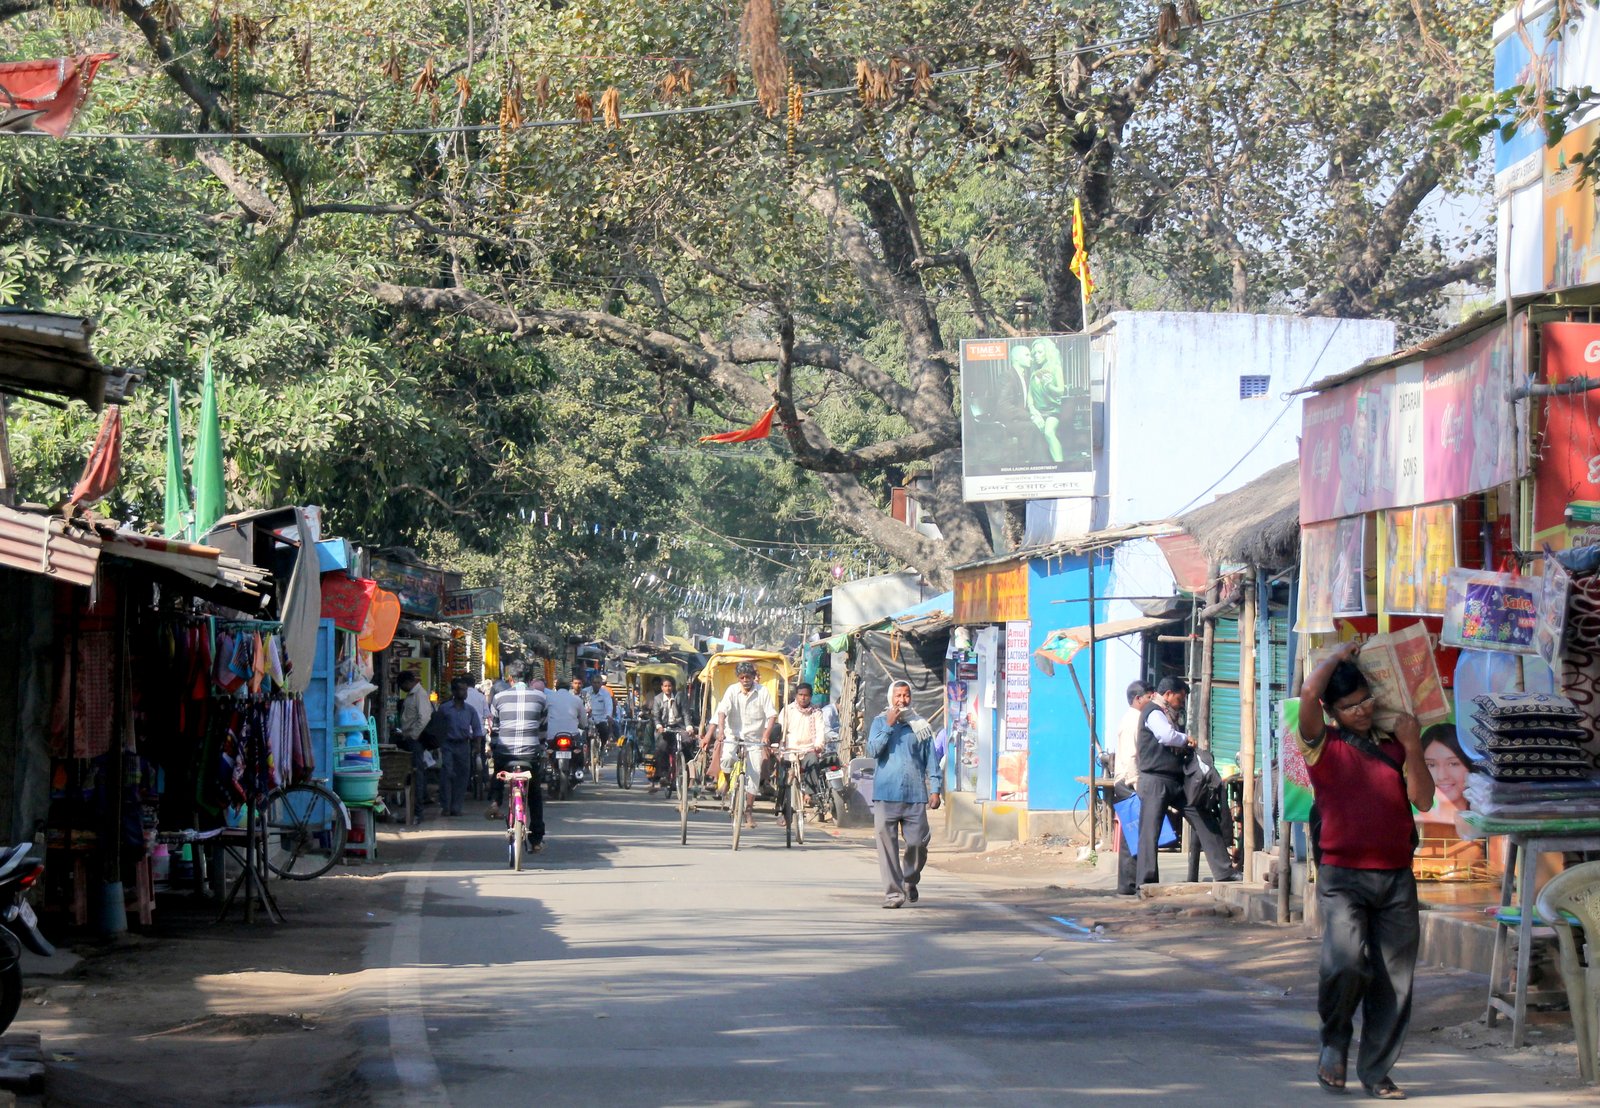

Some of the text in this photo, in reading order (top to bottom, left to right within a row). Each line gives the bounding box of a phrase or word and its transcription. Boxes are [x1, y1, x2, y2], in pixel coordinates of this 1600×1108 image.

[970, 345, 1001, 354] TIMEX
[1008, 629, 1026, 638] Amul
[1008, 639, 1028, 648] BUTTER
[1008, 662, 1028, 671] CERELAC
[1007, 677, 1028, 686] Horlicks
